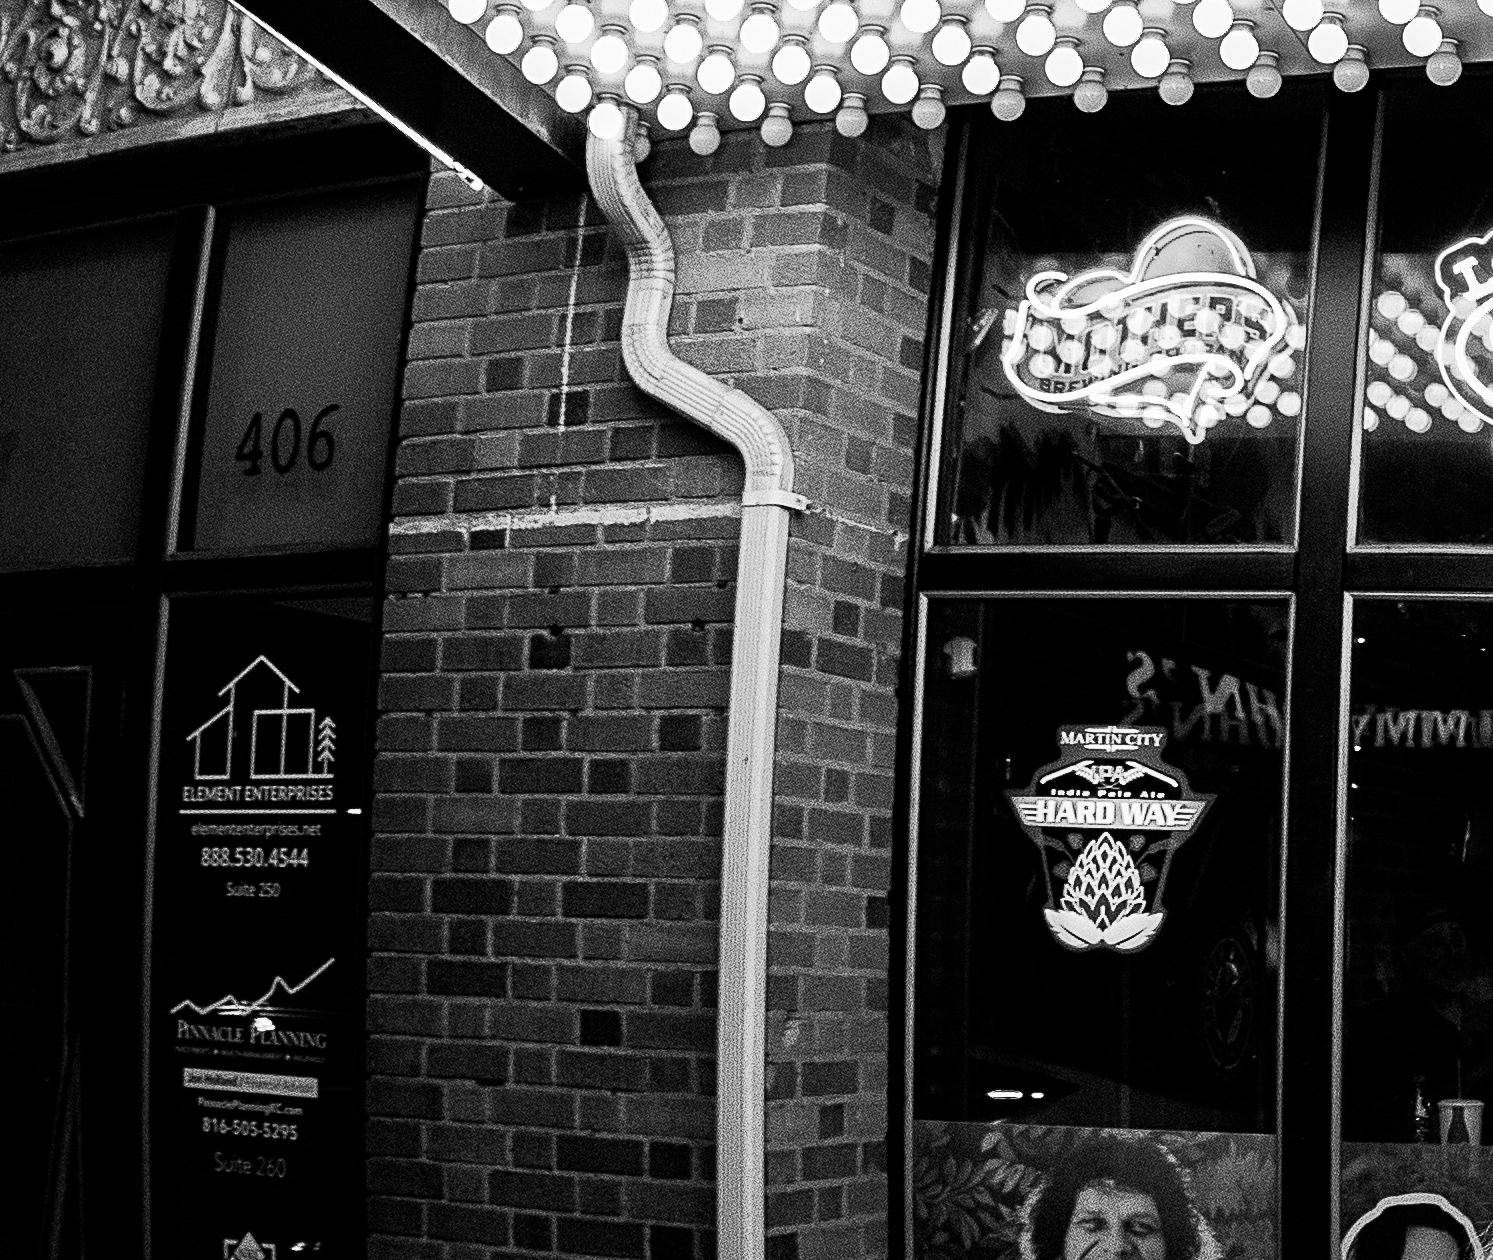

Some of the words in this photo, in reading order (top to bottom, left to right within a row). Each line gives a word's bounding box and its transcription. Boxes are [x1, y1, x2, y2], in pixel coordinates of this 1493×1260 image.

[235, 404, 340, 476] 406
[1060, 731, 1122, 745] MARTIN
[1125, 733, 1164, 747] CITY
[182, 785, 242, 802] ELEMENT
[245, 785, 334, 801] ENTERPRISES
[1051, 788, 1090, 797] India
[1097, 789, 1132, 798] Pale
[1139, 790, 1166, 799] Ale
[1036, 799, 1115, 825] HARD
[1121, 801, 1177, 827] WAY
[200, 847, 309, 868] 888.530.4544
[225, 881, 256, 897] Suite
[177, 1019, 244, 1043] PINNACLE
[249, 1022, 327, 1049] PLANNING
[202, 1117, 298, 1141] 816-505-5295
[214, 1151, 251, 1174] Suite
[256, 1155, 287, 1178] 260
